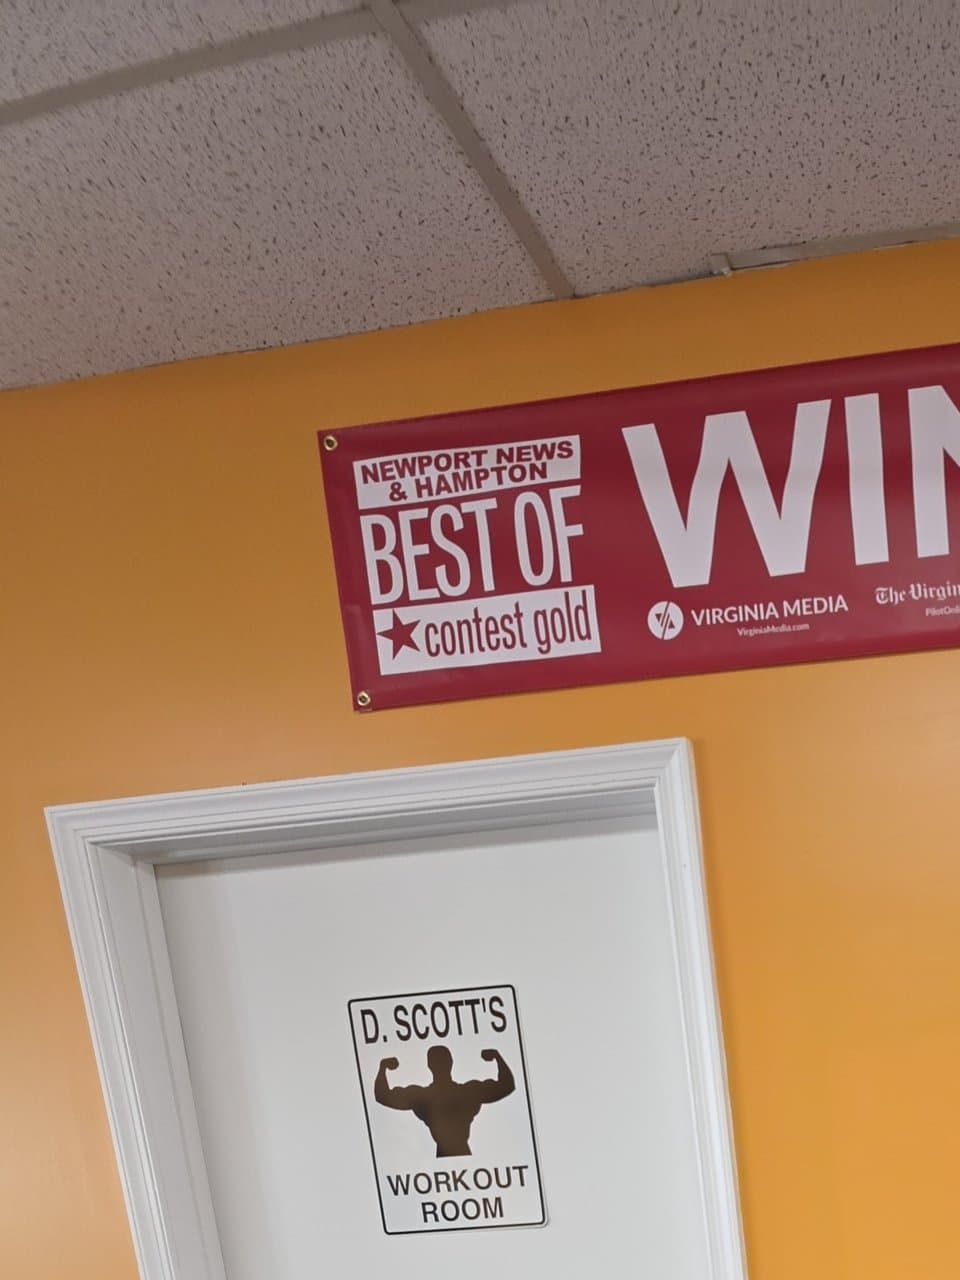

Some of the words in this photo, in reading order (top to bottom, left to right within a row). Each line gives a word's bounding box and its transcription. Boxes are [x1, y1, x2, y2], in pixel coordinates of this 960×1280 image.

[361, 450, 488, 485] NEWPORT
[496, 440, 574, 463] NEWS
[388, 482, 408, 502] &
[415, 462, 548, 498] HAMPTON
[360, 497, 497, 605] BEST
[514, 485, 584, 586] OF
[691, 601, 780, 627] VIRGINIA
[783, 594, 849, 616] MEDIA
[874, 586, 907, 605] The
[424, 601, 527, 657] contest
[534, 589, 592, 655] gold
[736, 621, 810, 638] VirginiaMedia.com
[360, 1008, 388, 1044] D.
[394, 996, 507, 1041] SCOTT'S
[387, 1165, 529, 1197] WORKOUT
[421, 1197, 504, 1223] ROOM
